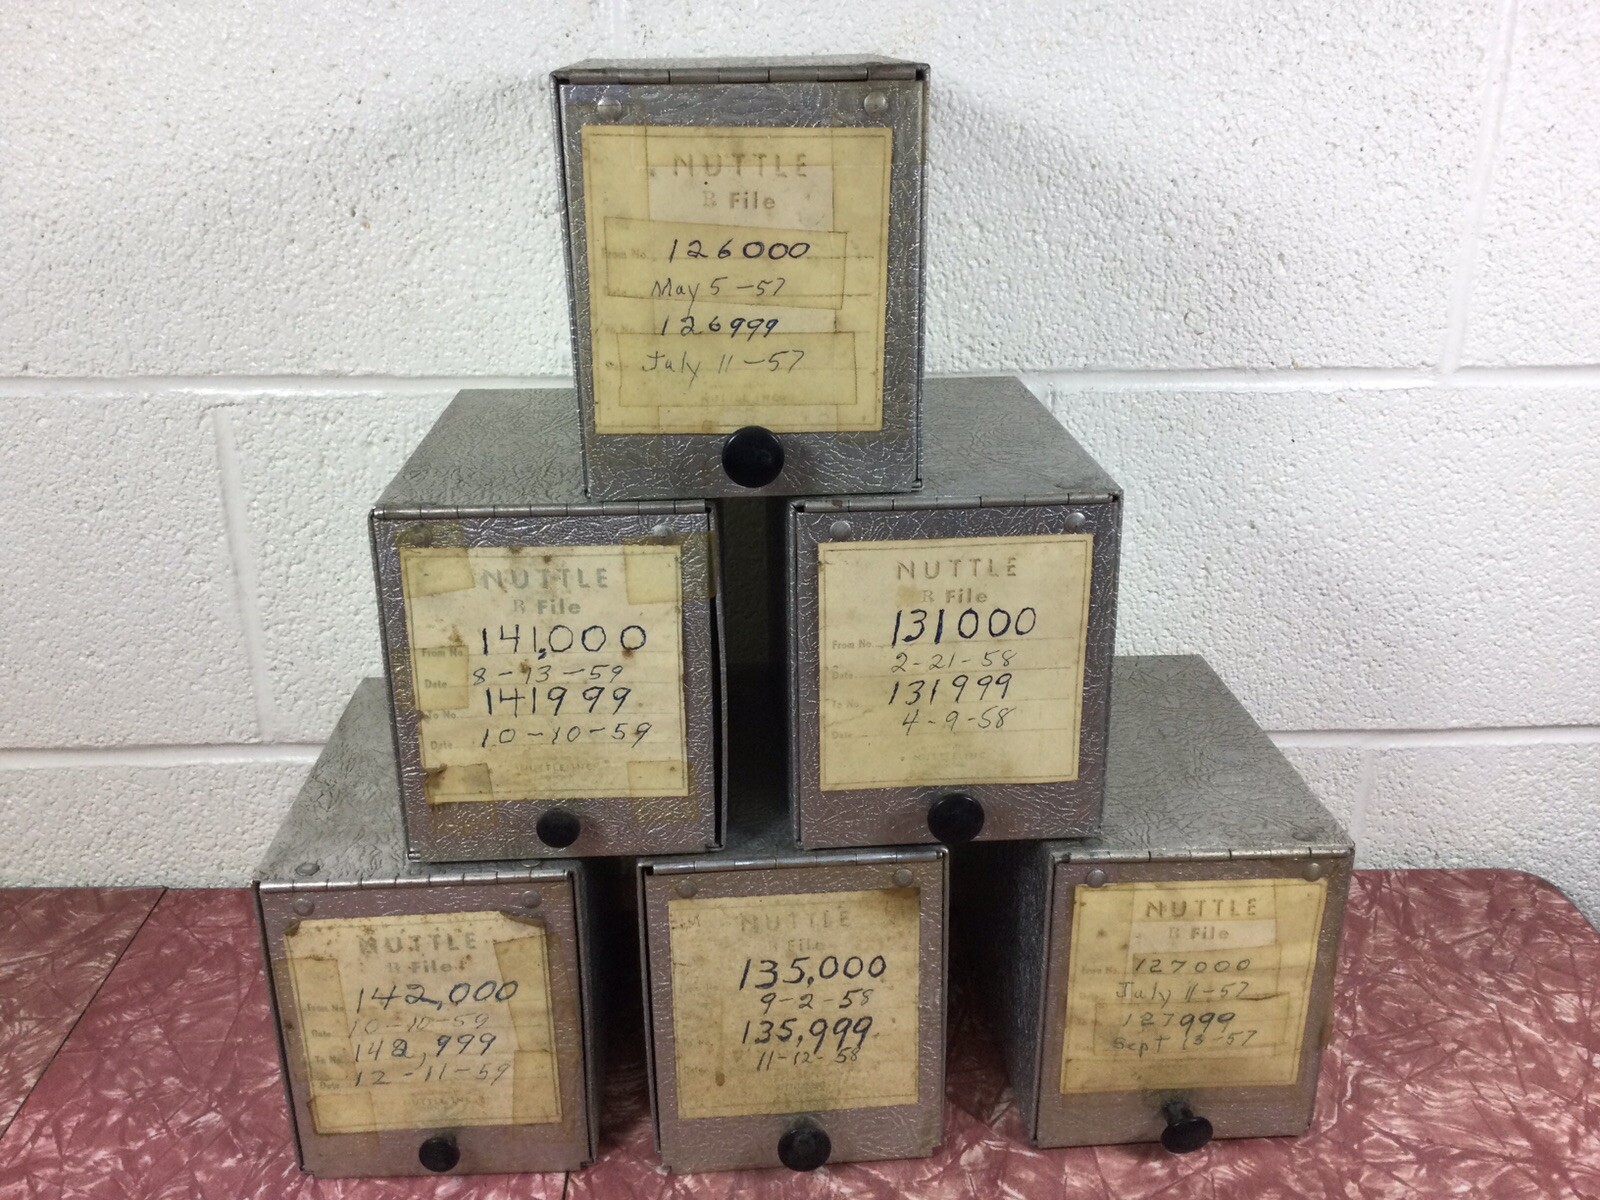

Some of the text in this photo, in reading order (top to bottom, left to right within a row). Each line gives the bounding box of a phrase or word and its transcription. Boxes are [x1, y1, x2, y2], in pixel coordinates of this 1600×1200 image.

[673, 152, 808, 177] NUTTLE
[729, 191, 776, 210] File
[669, 238, 811, 263] 126000
[651, 277, 700, 316] May
[661, 316, 779, 341] 126999
[642, 350, 700, 389] July
[482, 567, 609, 590] NUTTLE
[897, 557, 1018, 580] NUTTLE
[537, 598, 581, 615] File
[945, 587, 988, 604] File
[891, 607, 1037, 648] 131000
[482, 624, 647, 660] 141,000
[832, 640, 855, 650] From
[424, 679, 448, 689] Date
[832, 671, 854, 680] Date
[888, 673, 1012, 705] 131999
[485, 686, 632, 718] 141999
[1146, 898, 1256, 918] NUTTLE
[741, 911, 850, 933] NUTTLE
[1191, 926, 1229, 939] File
[359, 933, 477, 954] NUTTLE
[411, 960, 452, 973] File
[739, 955, 887, 991] 135,000
[1135, 958, 1251, 973] 127000
[356, 980, 518, 1013] 142,000
[1115, 981, 1172, 1008] July
[1122, 1011, 1236, 1034] 127999
[742, 1016, 874, 1053] 135,999
